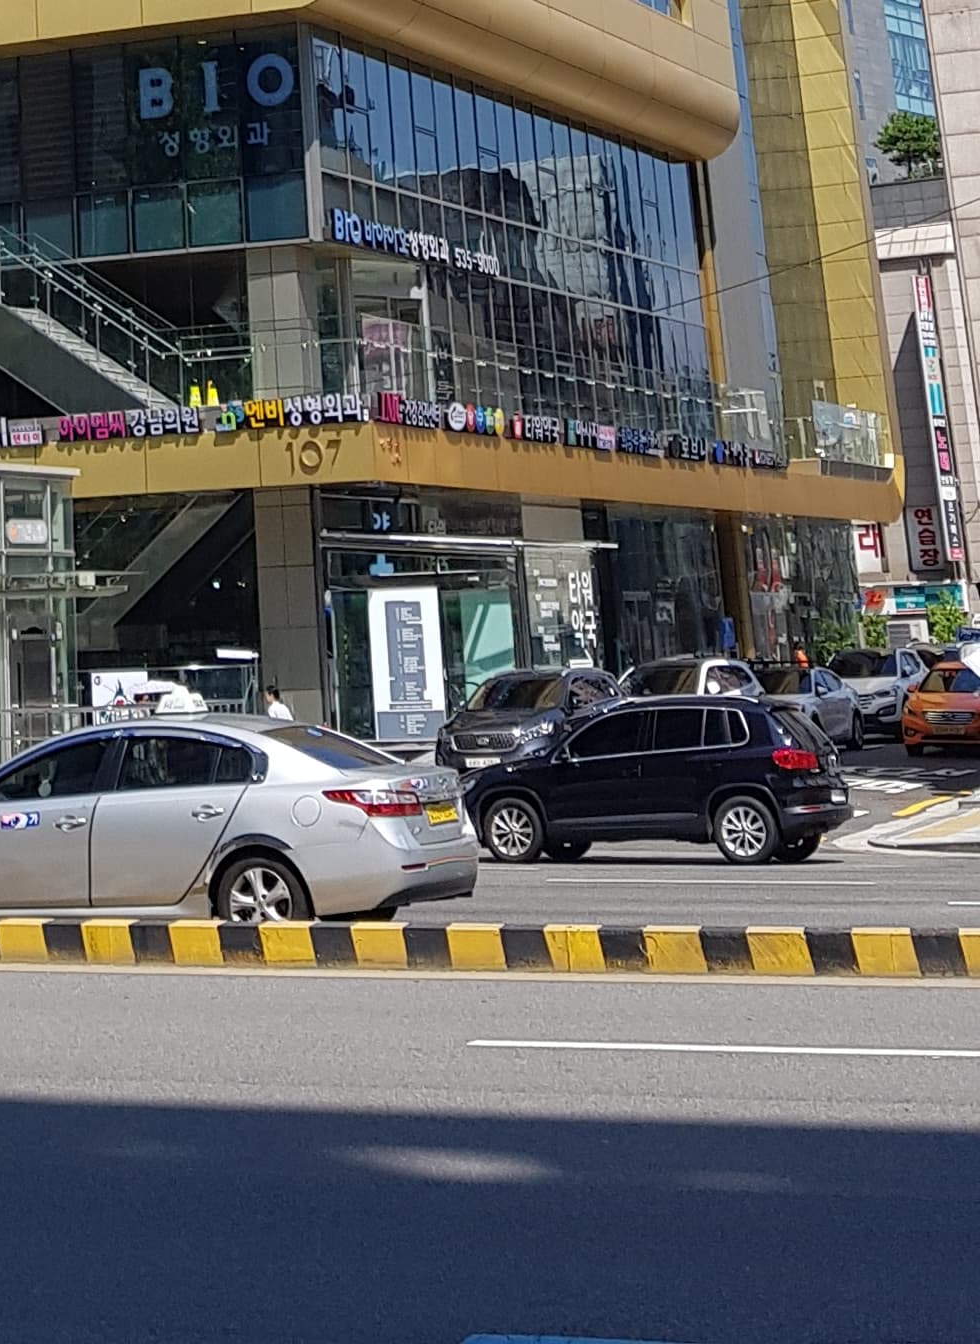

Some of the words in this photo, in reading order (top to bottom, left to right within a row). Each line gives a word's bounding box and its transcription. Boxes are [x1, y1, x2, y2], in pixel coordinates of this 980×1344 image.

[138, 53, 295, 120] BIO
[157, 121, 271, 157] 성형외과
[333, 208, 362, 244] BIO
[129, 405, 200, 437] 강남의원
[284, 437, 342, 477] 107
[914, 507, 940, 567] 연습장
